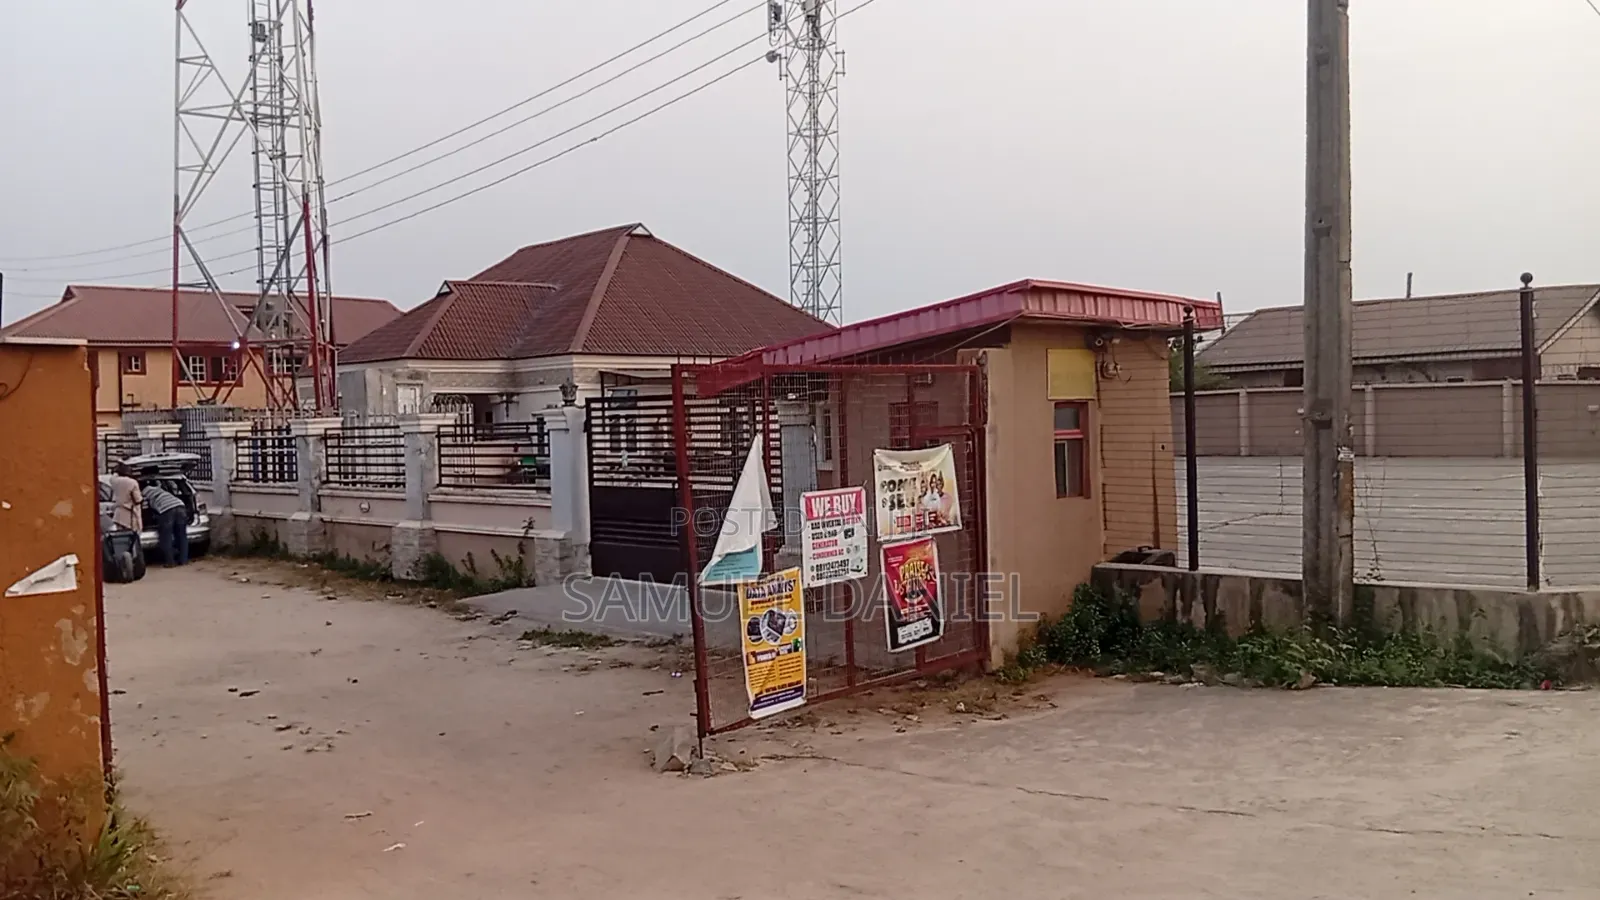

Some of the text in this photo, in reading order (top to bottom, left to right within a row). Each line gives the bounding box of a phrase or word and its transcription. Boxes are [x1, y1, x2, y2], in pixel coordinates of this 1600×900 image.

[811, 492, 856, 518] WE BUY
[746, 586, 766, 600] DATA
